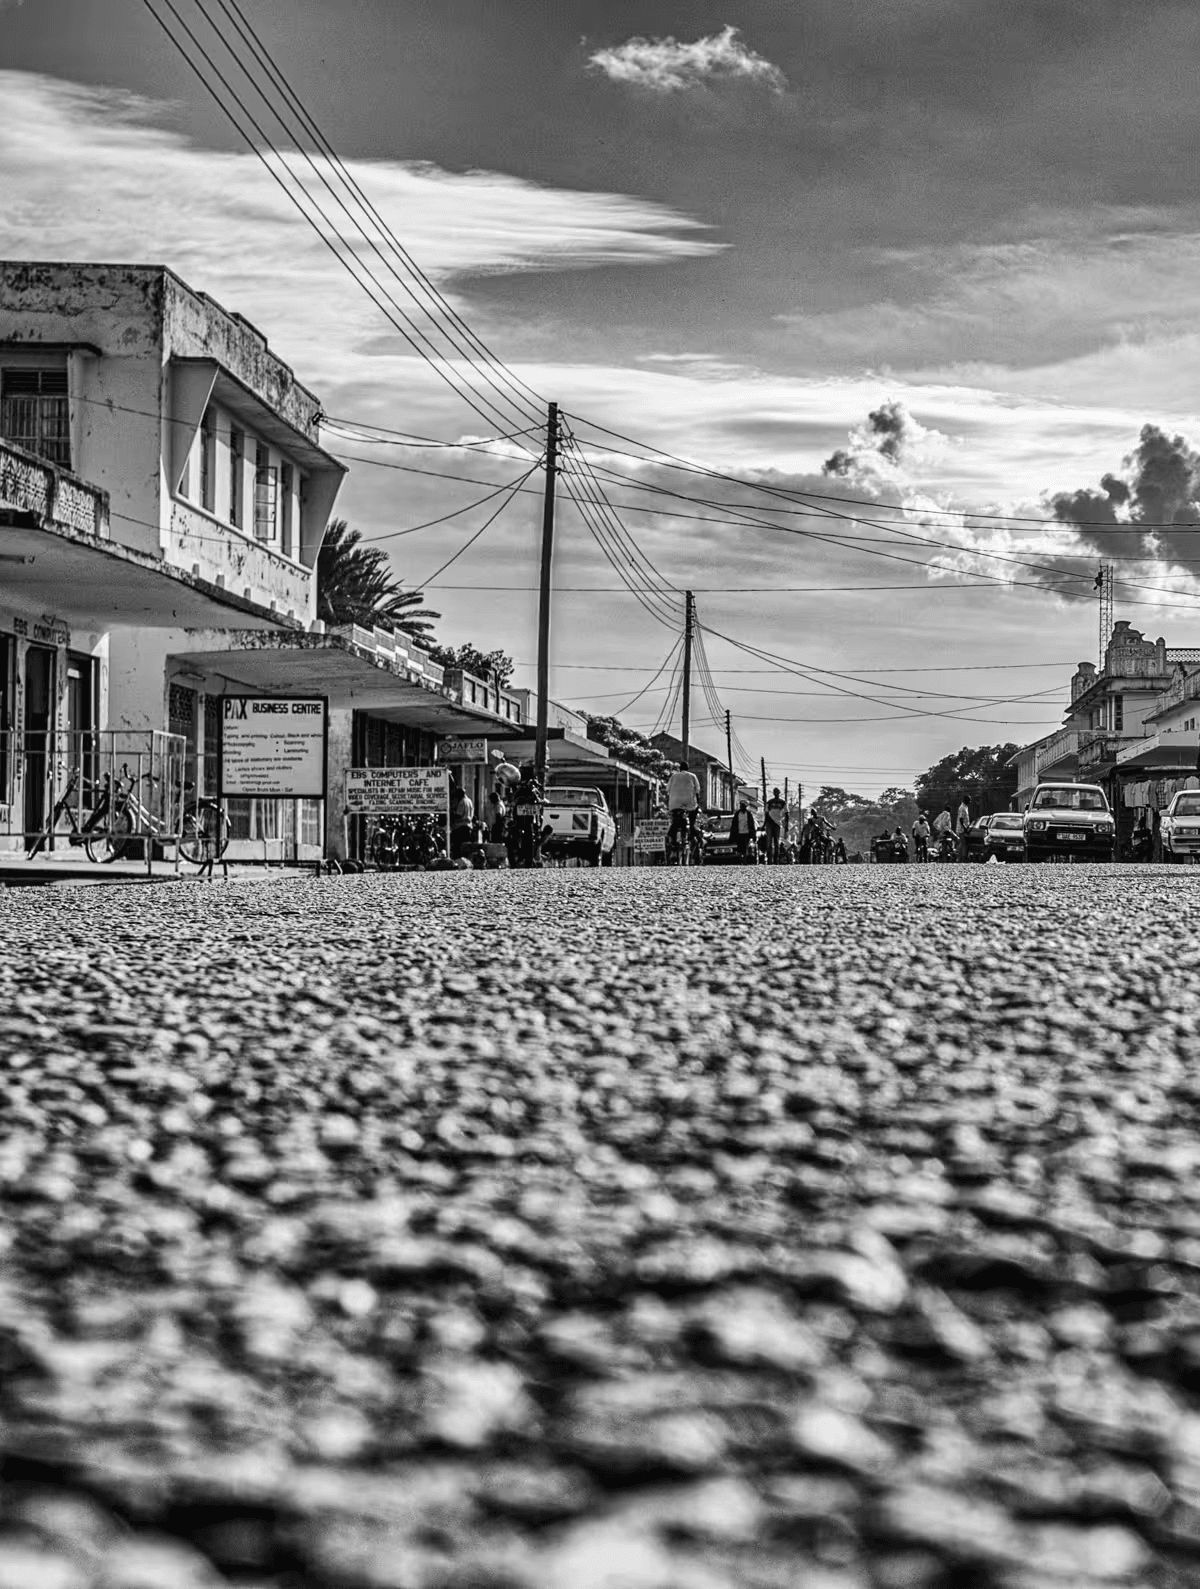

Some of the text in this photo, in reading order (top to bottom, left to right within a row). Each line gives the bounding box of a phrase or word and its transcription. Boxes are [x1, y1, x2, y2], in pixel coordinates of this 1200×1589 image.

[252, 702, 289, 714] BUSINESS
[291, 703, 322, 715] CENTRE
[351, 769, 442, 779] EBS COMPUTERS AND
[363, 778, 430, 787] INTERNET CAFE
